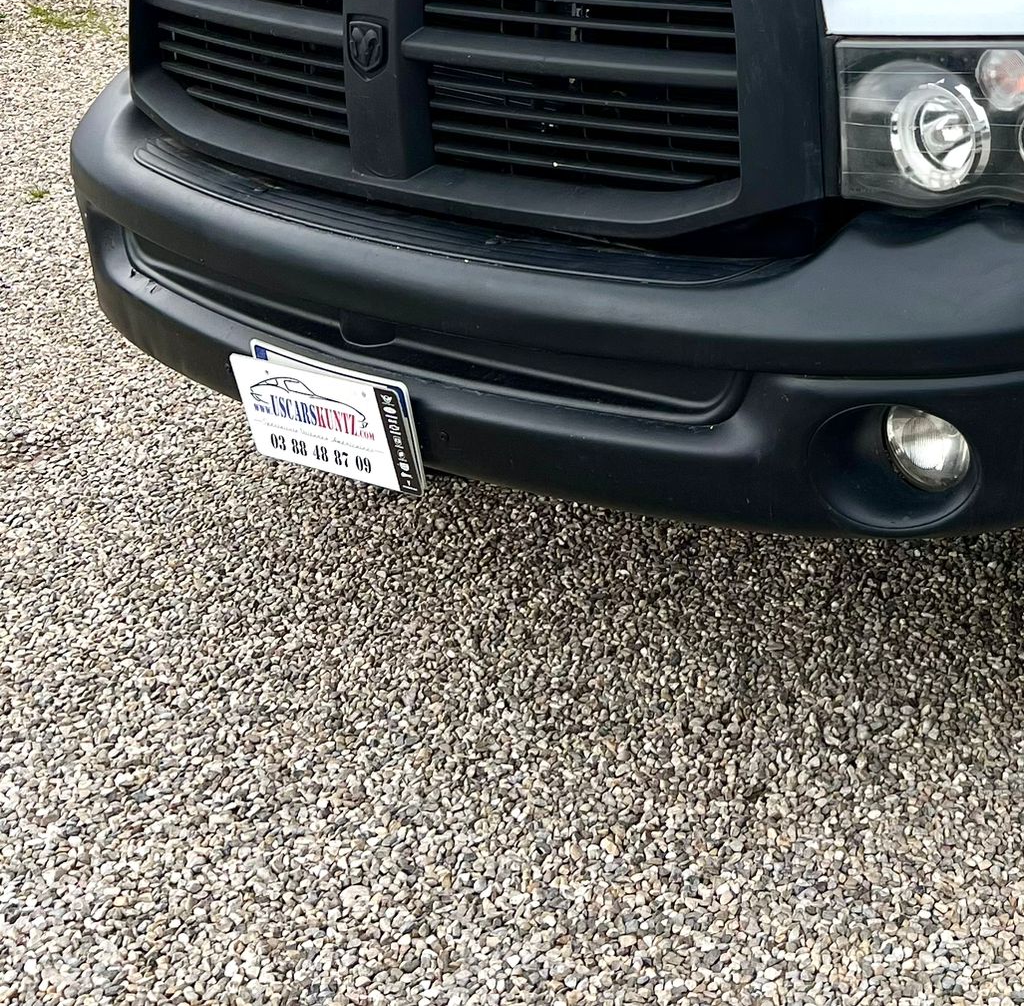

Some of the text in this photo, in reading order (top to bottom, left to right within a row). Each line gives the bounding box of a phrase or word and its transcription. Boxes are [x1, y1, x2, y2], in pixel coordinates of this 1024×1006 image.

[270, 433, 372, 474] 03 88 48 87 09
